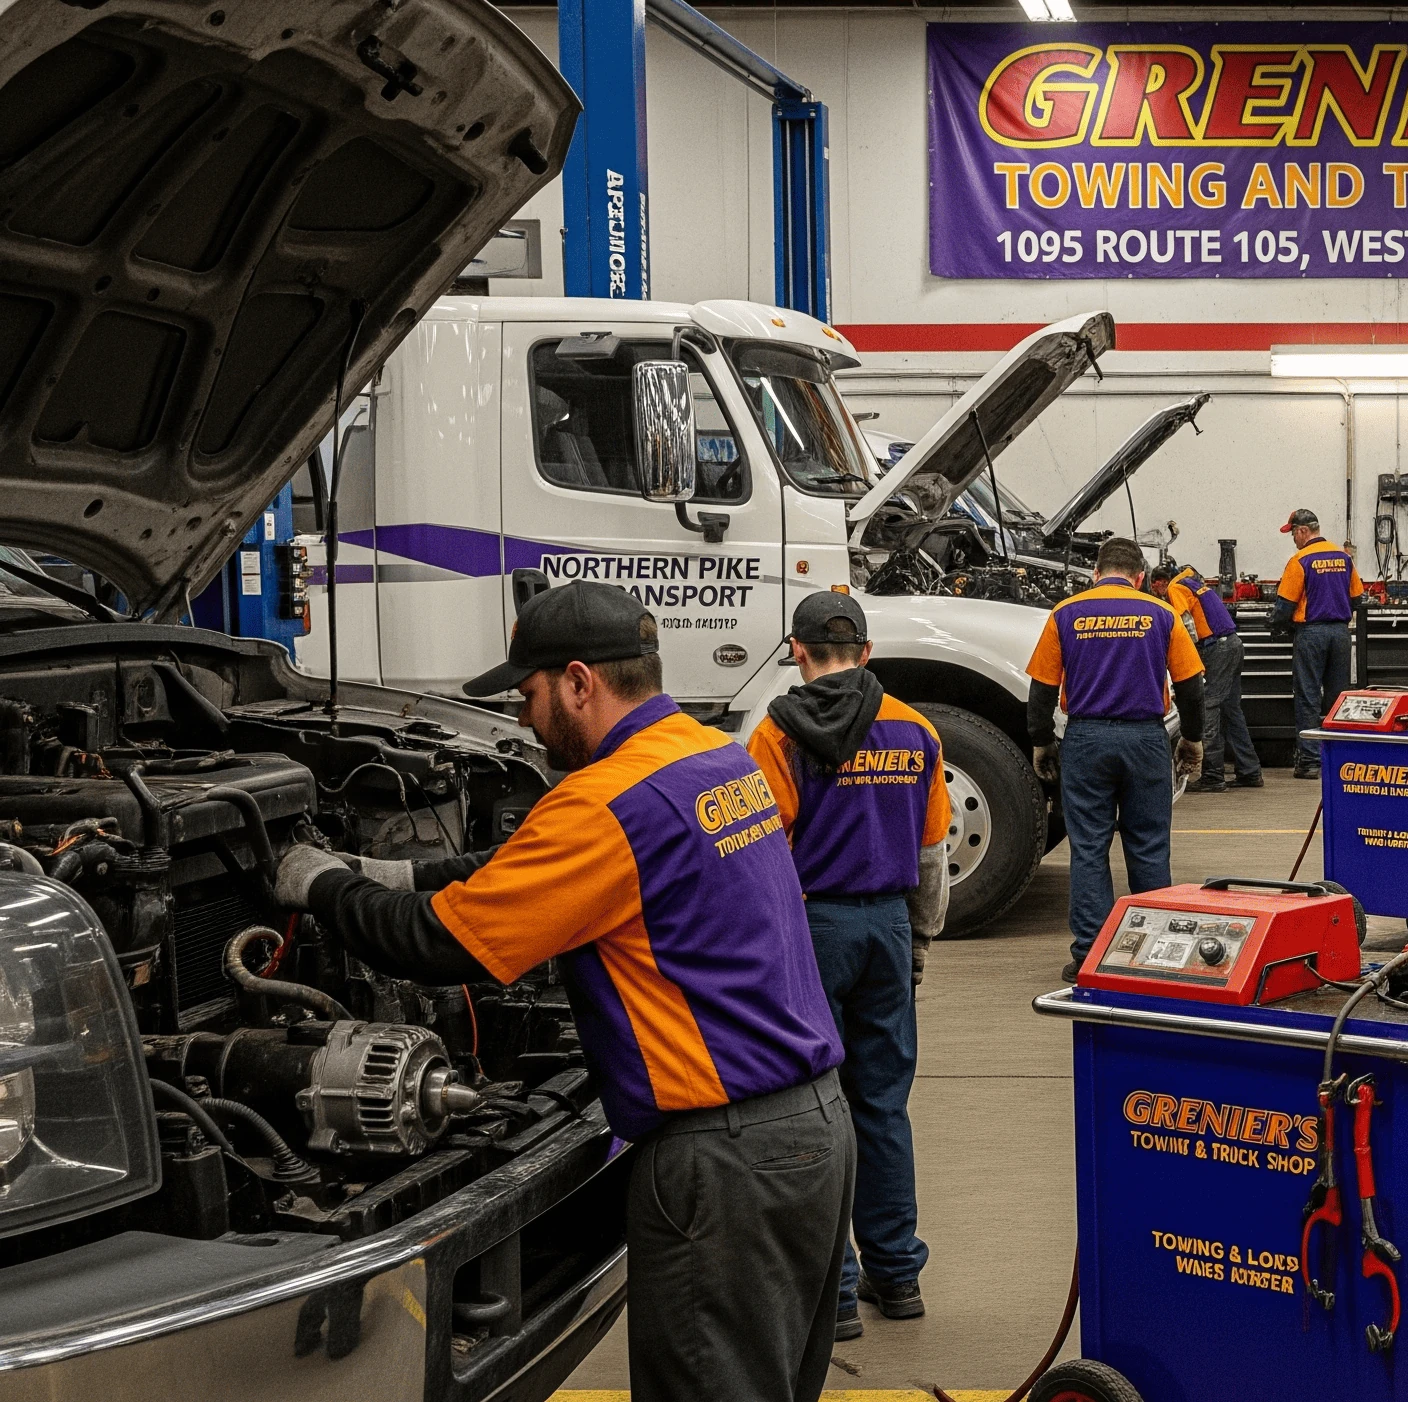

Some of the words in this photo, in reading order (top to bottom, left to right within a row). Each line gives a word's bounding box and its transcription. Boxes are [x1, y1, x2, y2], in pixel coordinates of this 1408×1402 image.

[994, 162, 1227, 209] TOWING
[1241, 162, 1365, 209] AND
[996, 229, 1083, 263] 1095
[1097, 229, 1222, 263] ROUTE
[1233, 229, 1310, 271] 105,
[543, 556, 690, 580] NORTHERN
[699, 556, 761, 580] PIKE
[615, 584, 754, 608] ANSPORT
[1123, 1090, 1320, 1152] GRENIER'S
[1212, 1142, 1260, 1168] TRUCK
[1267, 1152, 1316, 1175] SHOP
[1152, 1230, 1225, 1259] TOWING
